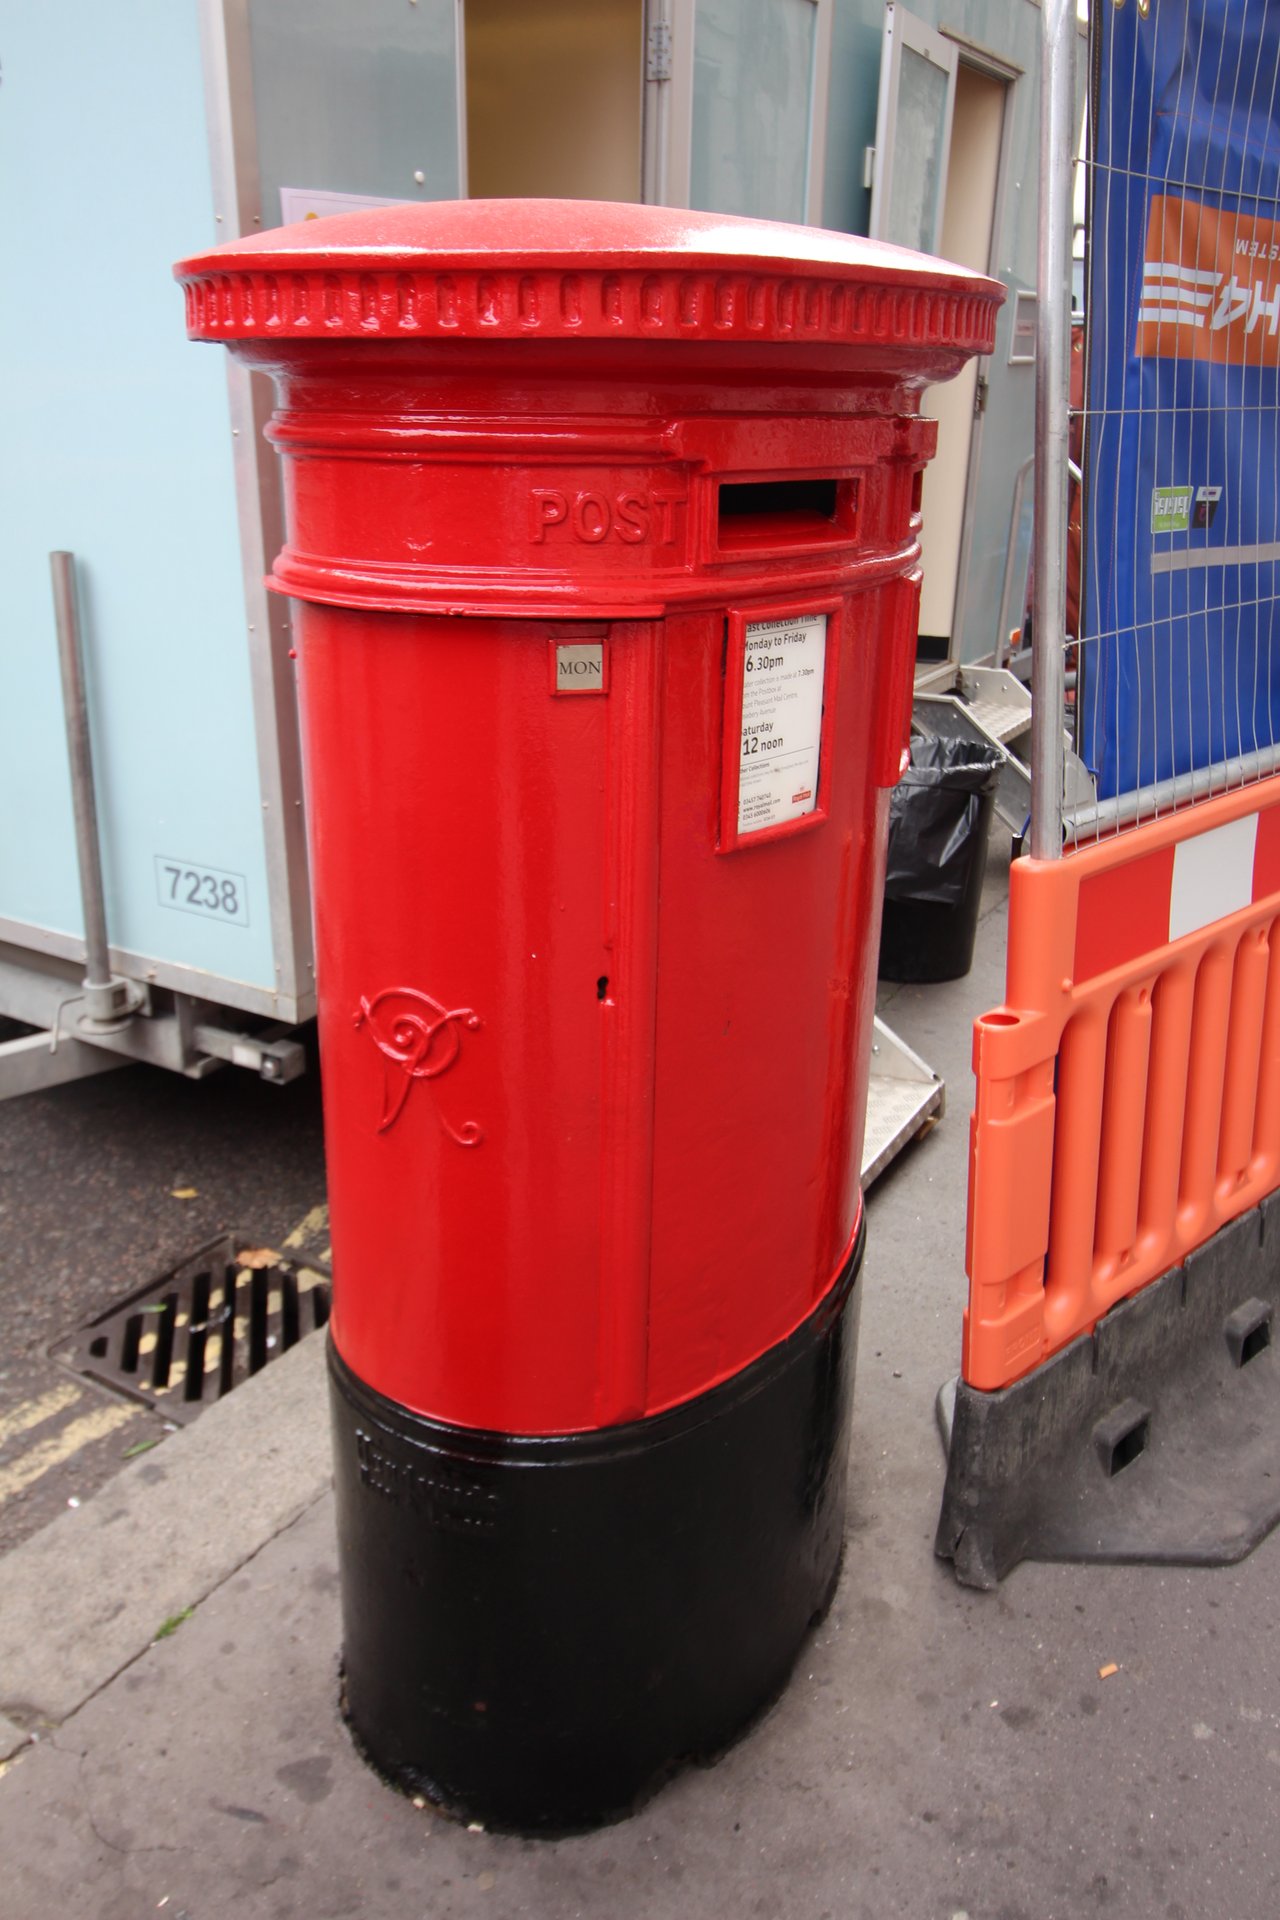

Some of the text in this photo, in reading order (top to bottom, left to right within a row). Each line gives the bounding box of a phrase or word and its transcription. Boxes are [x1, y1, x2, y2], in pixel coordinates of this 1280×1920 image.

[1235, 238, 1280, 261] STEM
[528, 487, 689, 545] POST
[747, 621, 760, 632] ast
[774, 636, 782, 646] to
[784, 631, 807, 644] Friday
[559, 660, 603, 675] MON
[746, 655, 784, 672] 6.30pm
[742, 721, 774, 736] aturday
[743, 736, 784, 756] 12 noon
[164, 866, 239, 915] 7238
